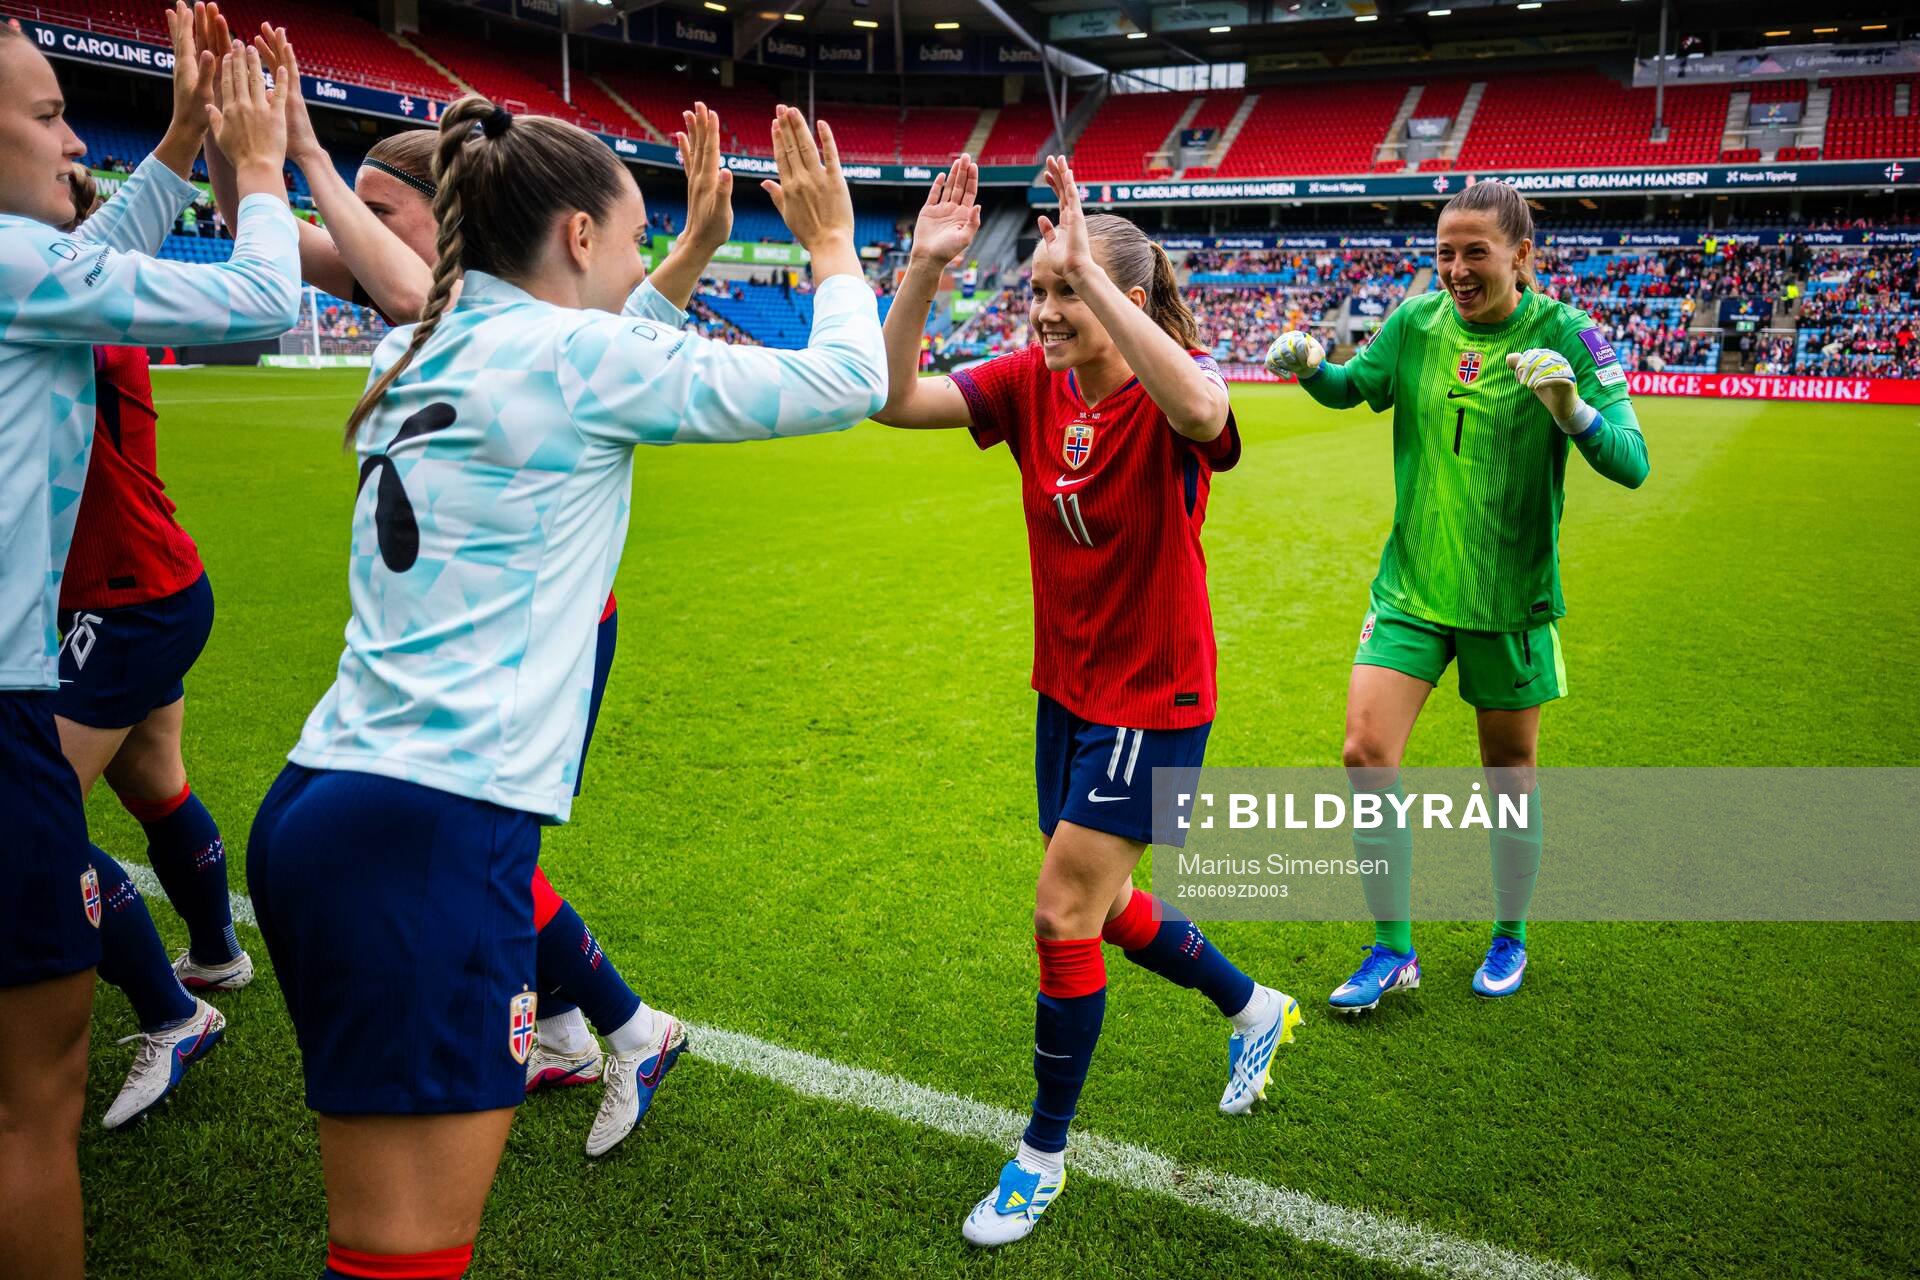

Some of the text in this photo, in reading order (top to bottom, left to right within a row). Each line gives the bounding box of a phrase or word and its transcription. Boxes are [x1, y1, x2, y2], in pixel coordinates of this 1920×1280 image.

[35, 27, 55, 46] 10
[62, 34, 151, 64] CAROLINE
[727, 156, 779, 173] CAROLIN
[1132, 185, 1190, 199] CAROLINE
[1191, 184, 1243, 198] GRAHAM
[1244, 182, 1296, 196] HANSEN
[1506, 175, 1575, 189] CAROLINE
[1577, 173, 1641, 188] GRAHAM
[1644, 172, 1708, 186] HANSEN
[1740, 172, 1764, 182] Norsk
[1765, 171, 1797, 184] Tipping
[1876, 233, 1899, 242] Norsk
[1628, 373, 1702, 395] ORGE
[1720, 376, 1871, 400] ØSTERRIKE
[1453, 407, 1466, 457] 1
[1052, 493, 1094, 548] 11
[1106, 727, 1145, 787] 11
